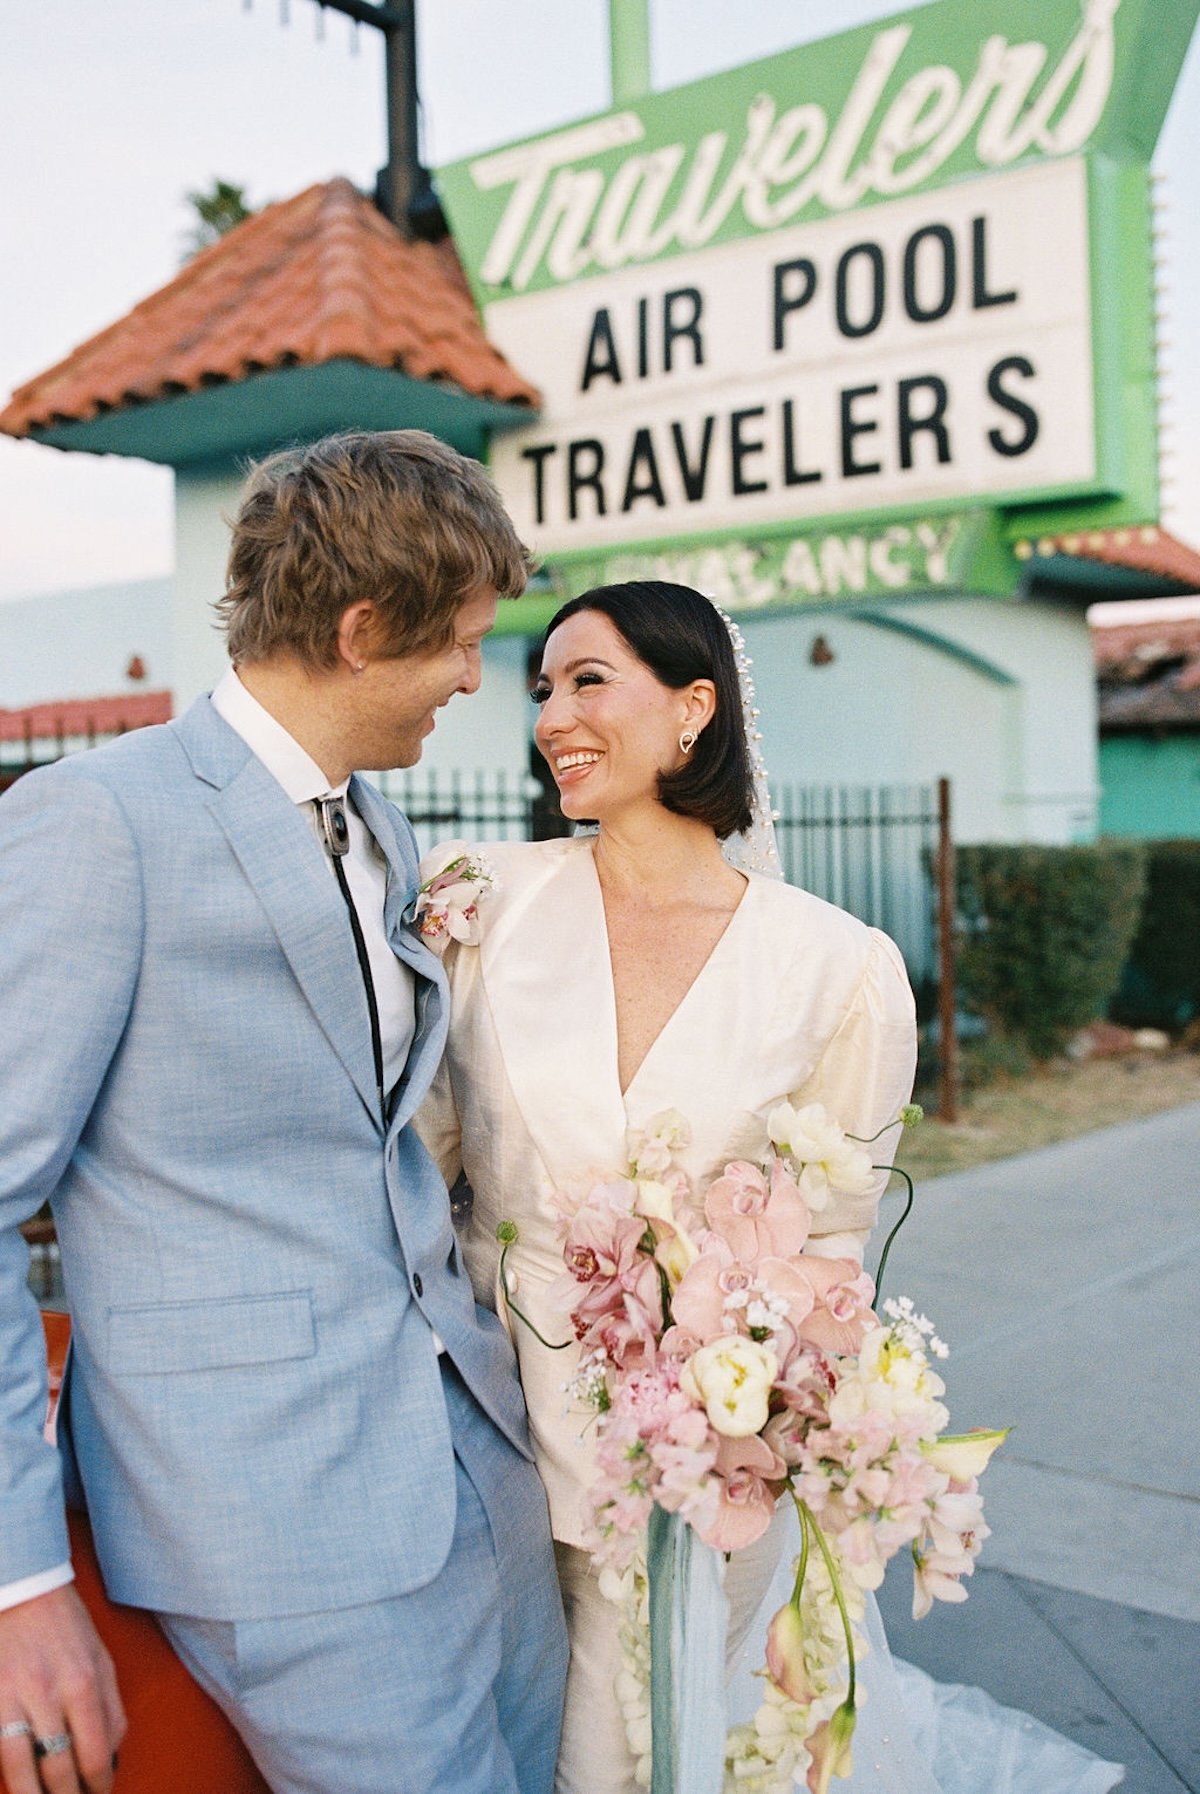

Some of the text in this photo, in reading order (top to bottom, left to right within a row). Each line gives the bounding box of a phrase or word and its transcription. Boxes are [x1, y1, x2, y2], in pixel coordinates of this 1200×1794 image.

[471, 0, 1119, 288] Travelers
[580, 216, 1018, 393] AIR POOL
